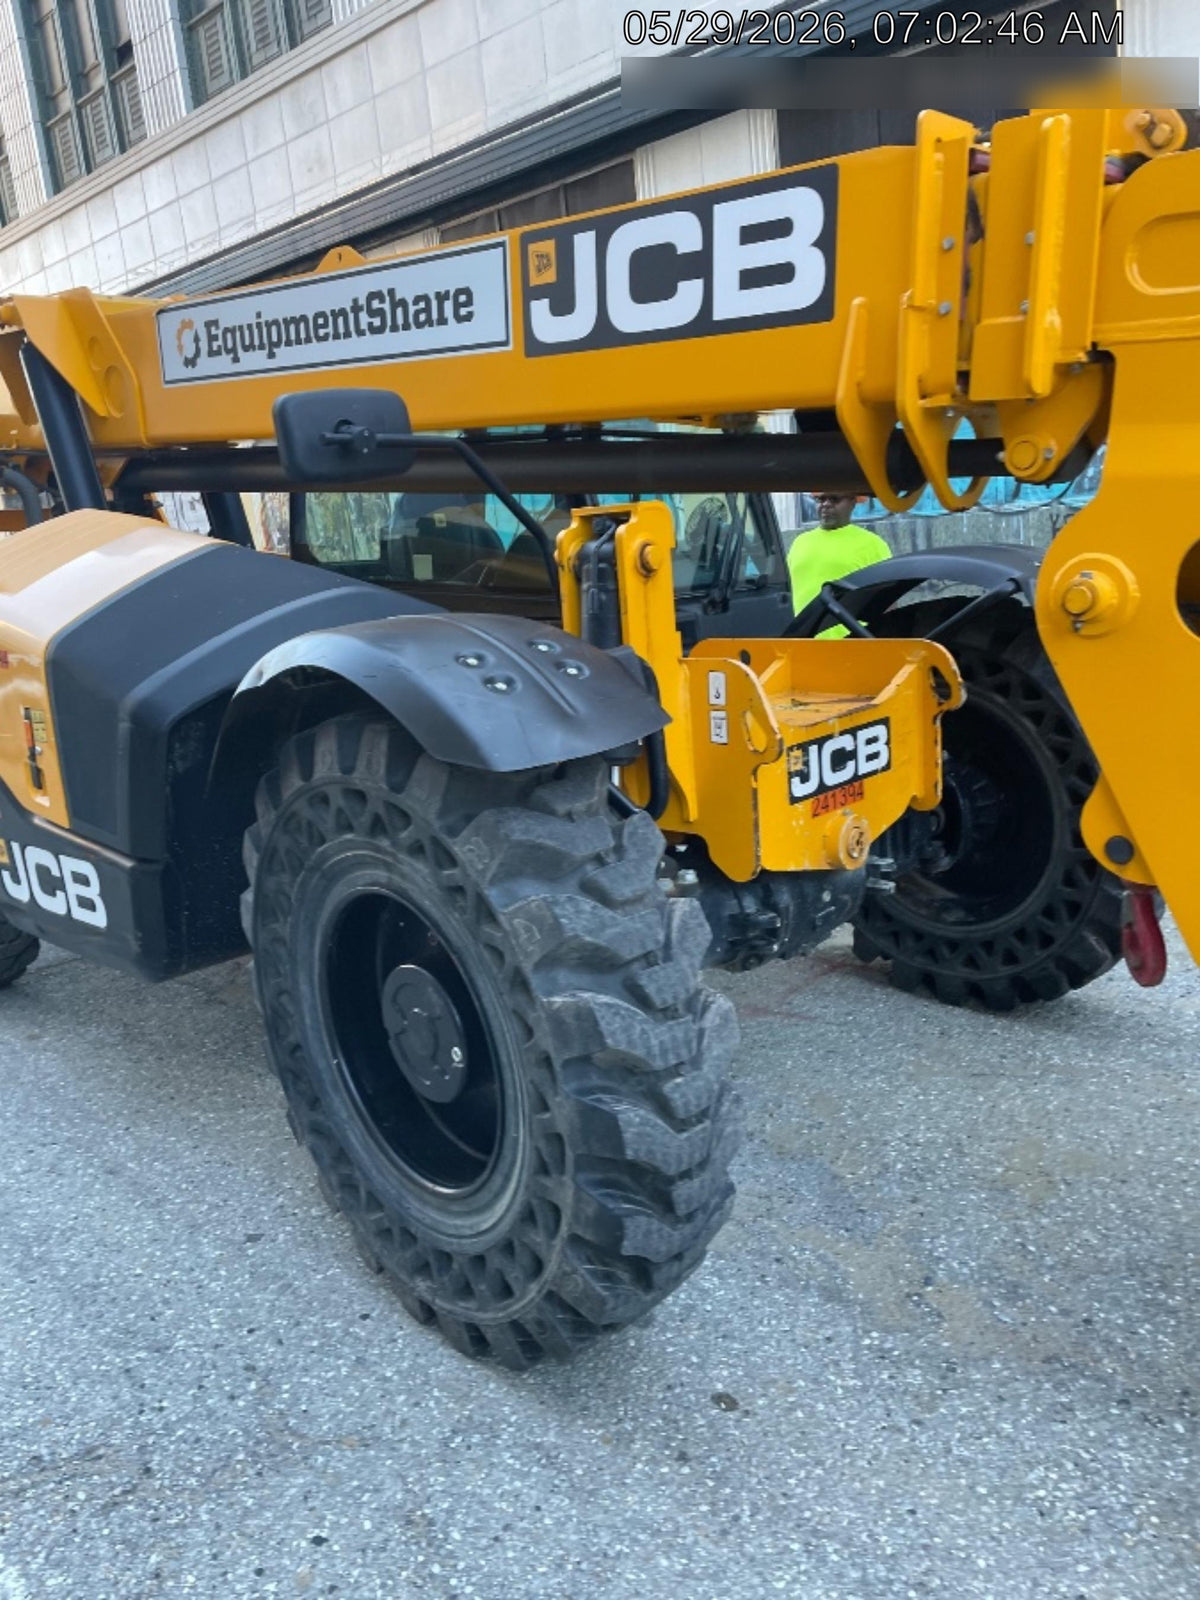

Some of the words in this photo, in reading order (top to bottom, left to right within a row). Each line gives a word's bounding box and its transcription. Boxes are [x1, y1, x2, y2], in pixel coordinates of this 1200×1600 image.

[529, 187, 826, 345] JCB
[205, 287, 475, 363] EquipmentShare
[790, 724, 889, 797] JCB
[812, 781, 864, 817] 241394
[1, 841, 107, 929] JCB
